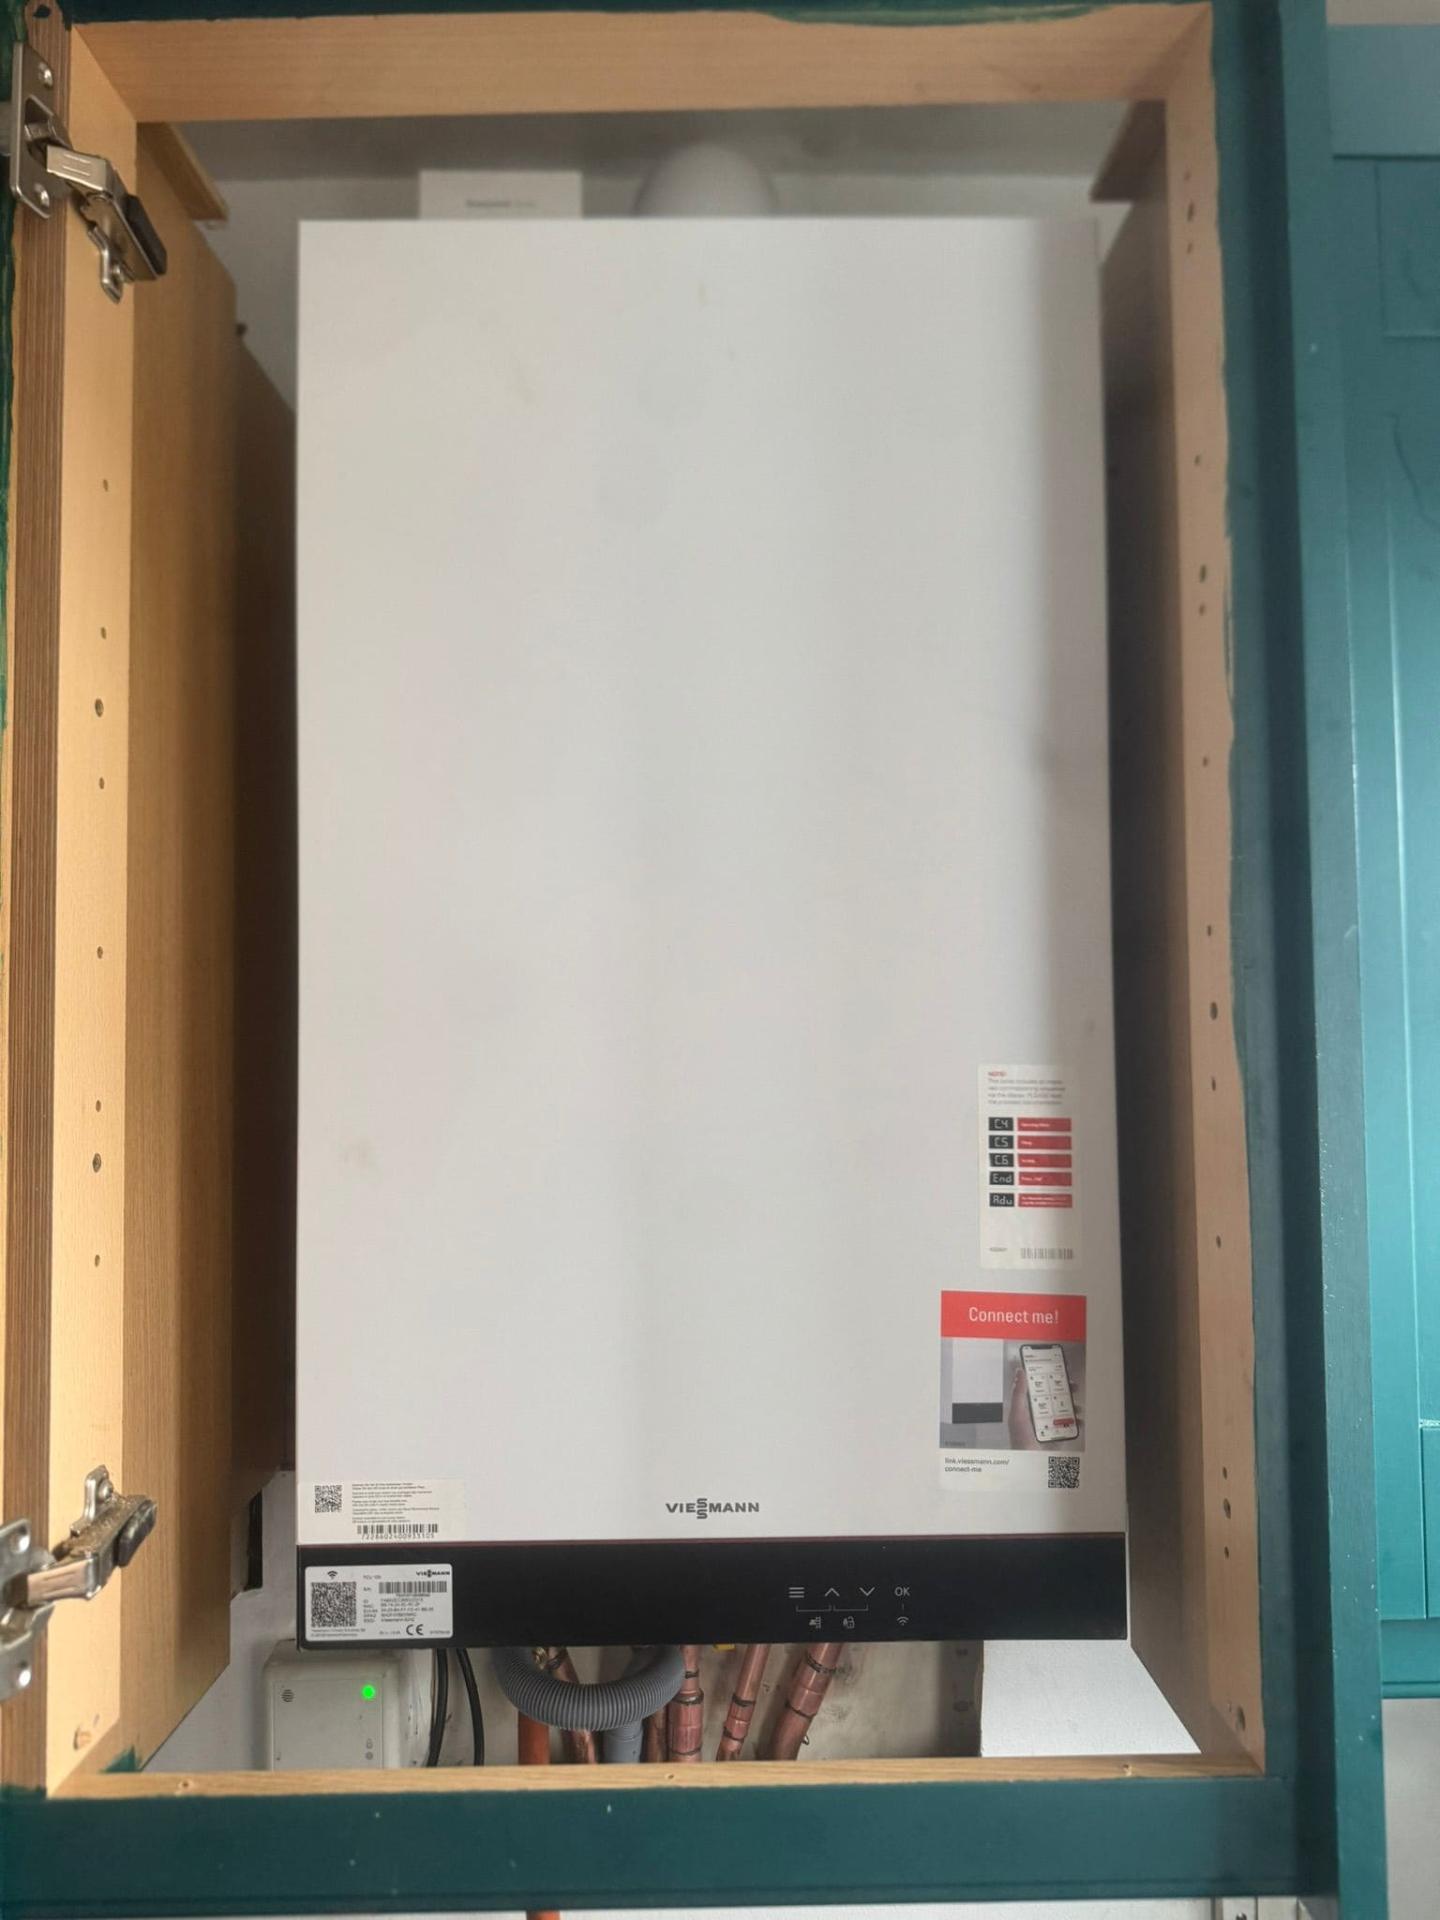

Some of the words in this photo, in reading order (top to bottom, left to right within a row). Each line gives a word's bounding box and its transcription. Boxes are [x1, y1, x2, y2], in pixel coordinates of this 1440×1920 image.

[992, 1173, 1012, 1183] End
[968, 1306, 1029, 1324] Connect
[1032, 1309, 1059, 1324] me!
[666, 1498, 760, 1520] VIESSMANN
[415, 1569, 451, 1578] VIESSMANN
[894, 1586, 911, 1598] OK
